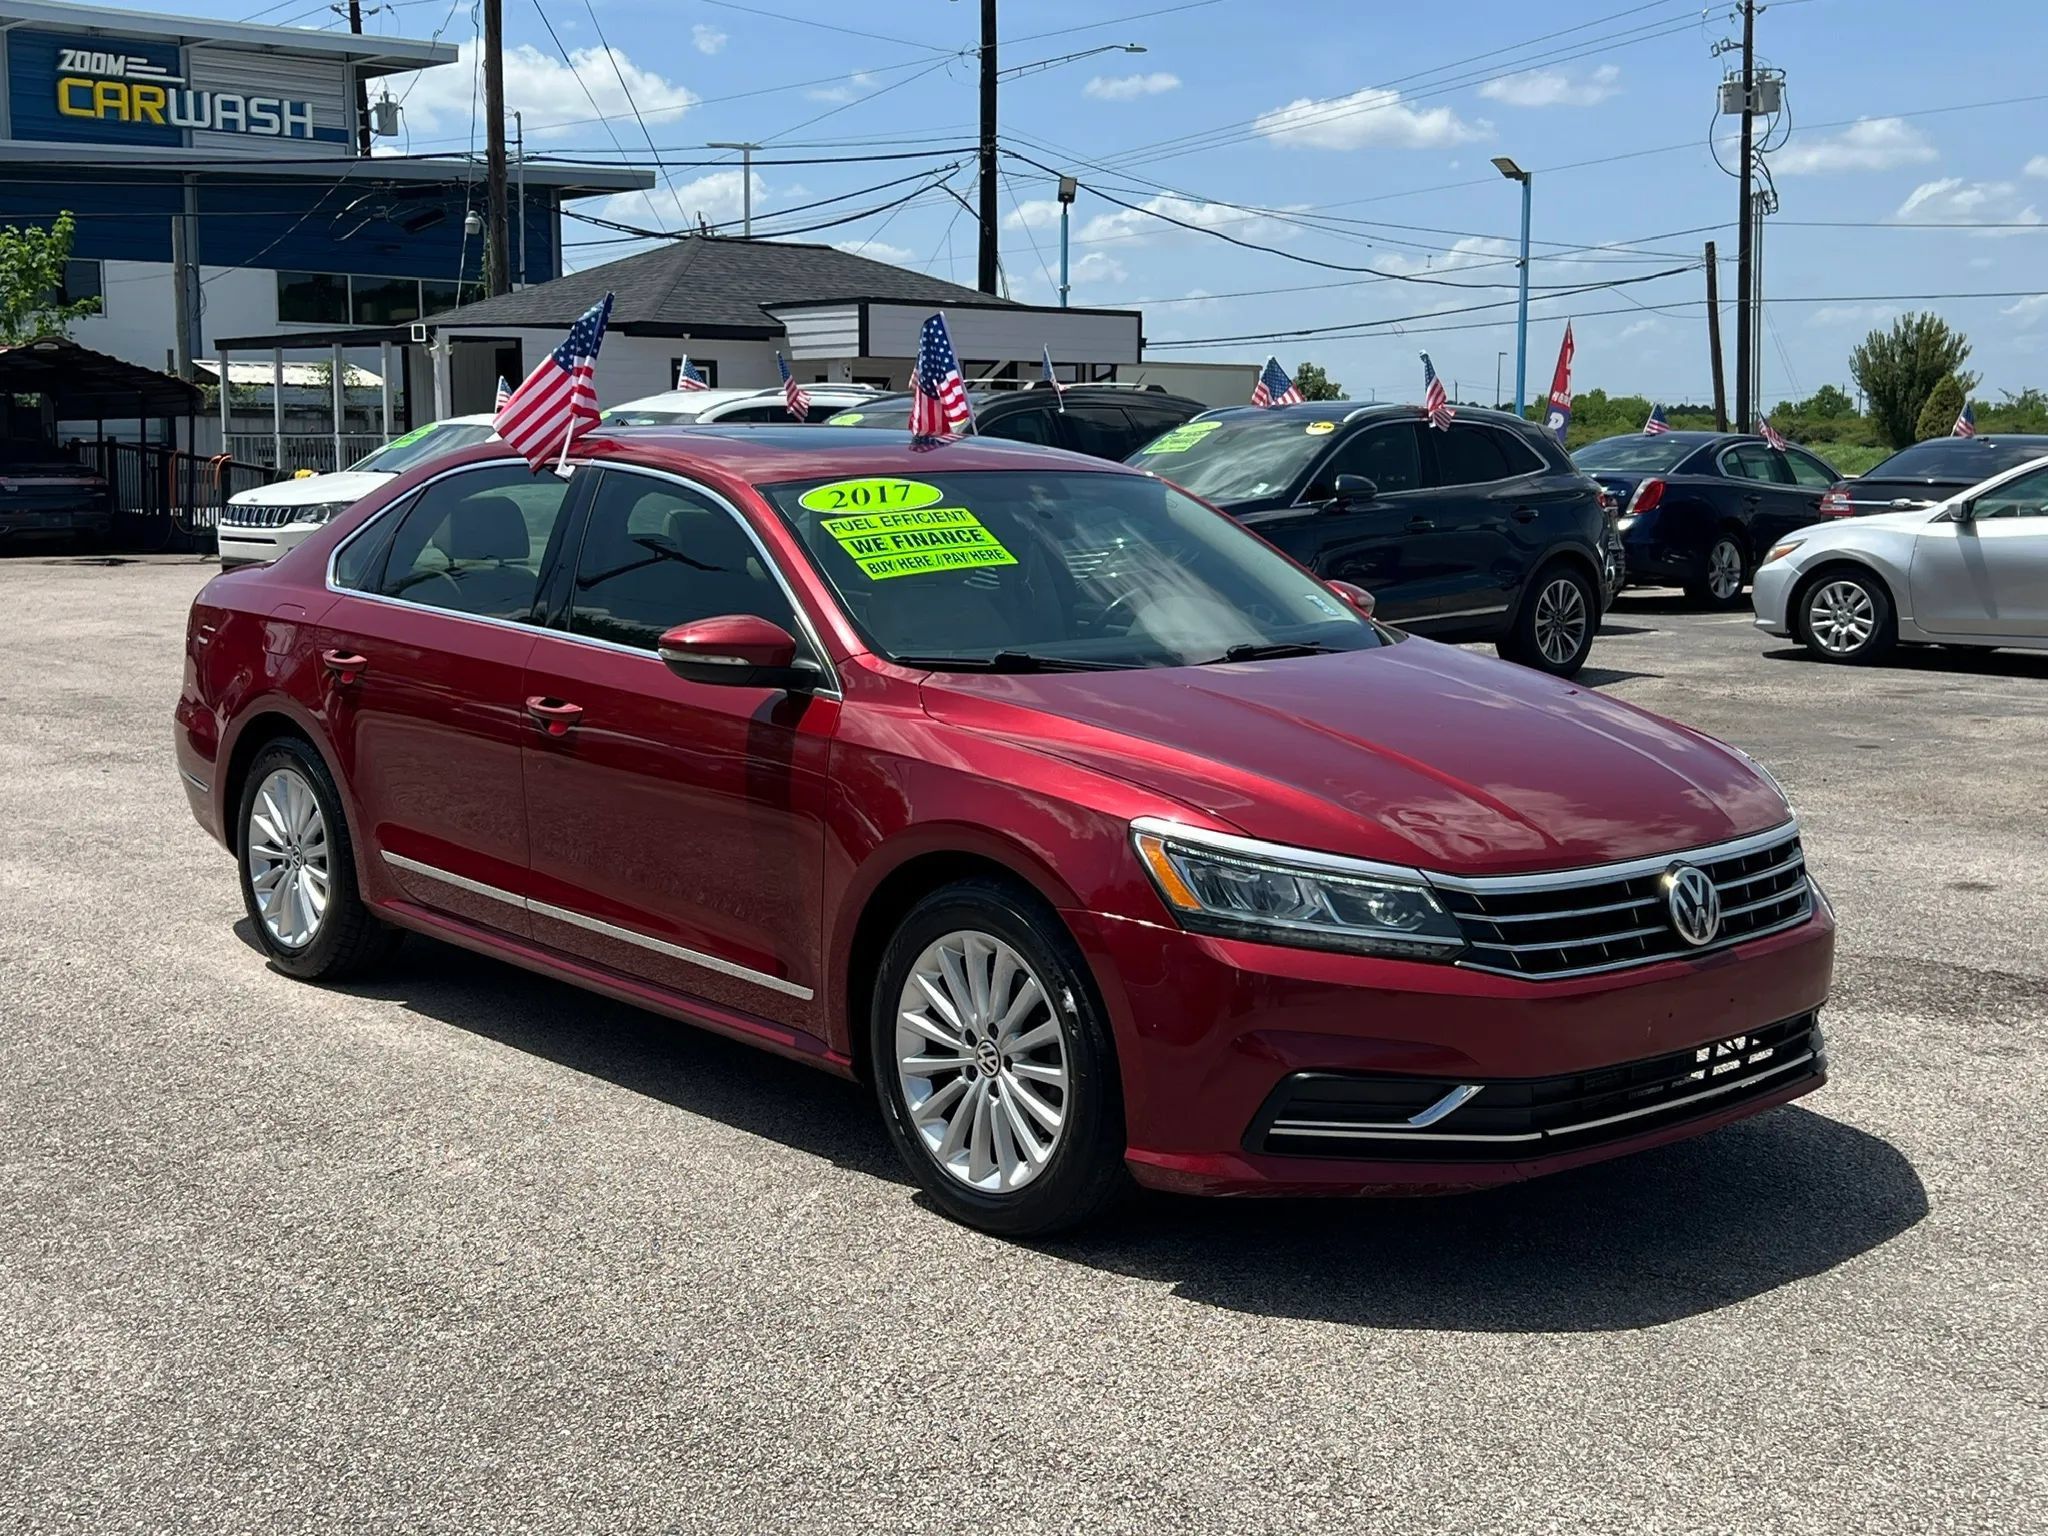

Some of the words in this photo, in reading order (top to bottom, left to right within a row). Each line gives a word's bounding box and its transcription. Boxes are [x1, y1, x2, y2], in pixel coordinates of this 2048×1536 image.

[58, 49, 126, 76] ZOOM
[828, 484, 911, 508] 2017
[828, 517, 877, 533] FUEL
[879, 510, 967, 527] EFFICIENT
[850, 537, 888, 555] WE
[893, 529, 984, 549] FINANCE
[868, 559, 895, 574] BUY
[900, 555, 932, 569] HERE
[943, 551, 968, 564] PAY
[970, 549, 1005, 561] HERE
